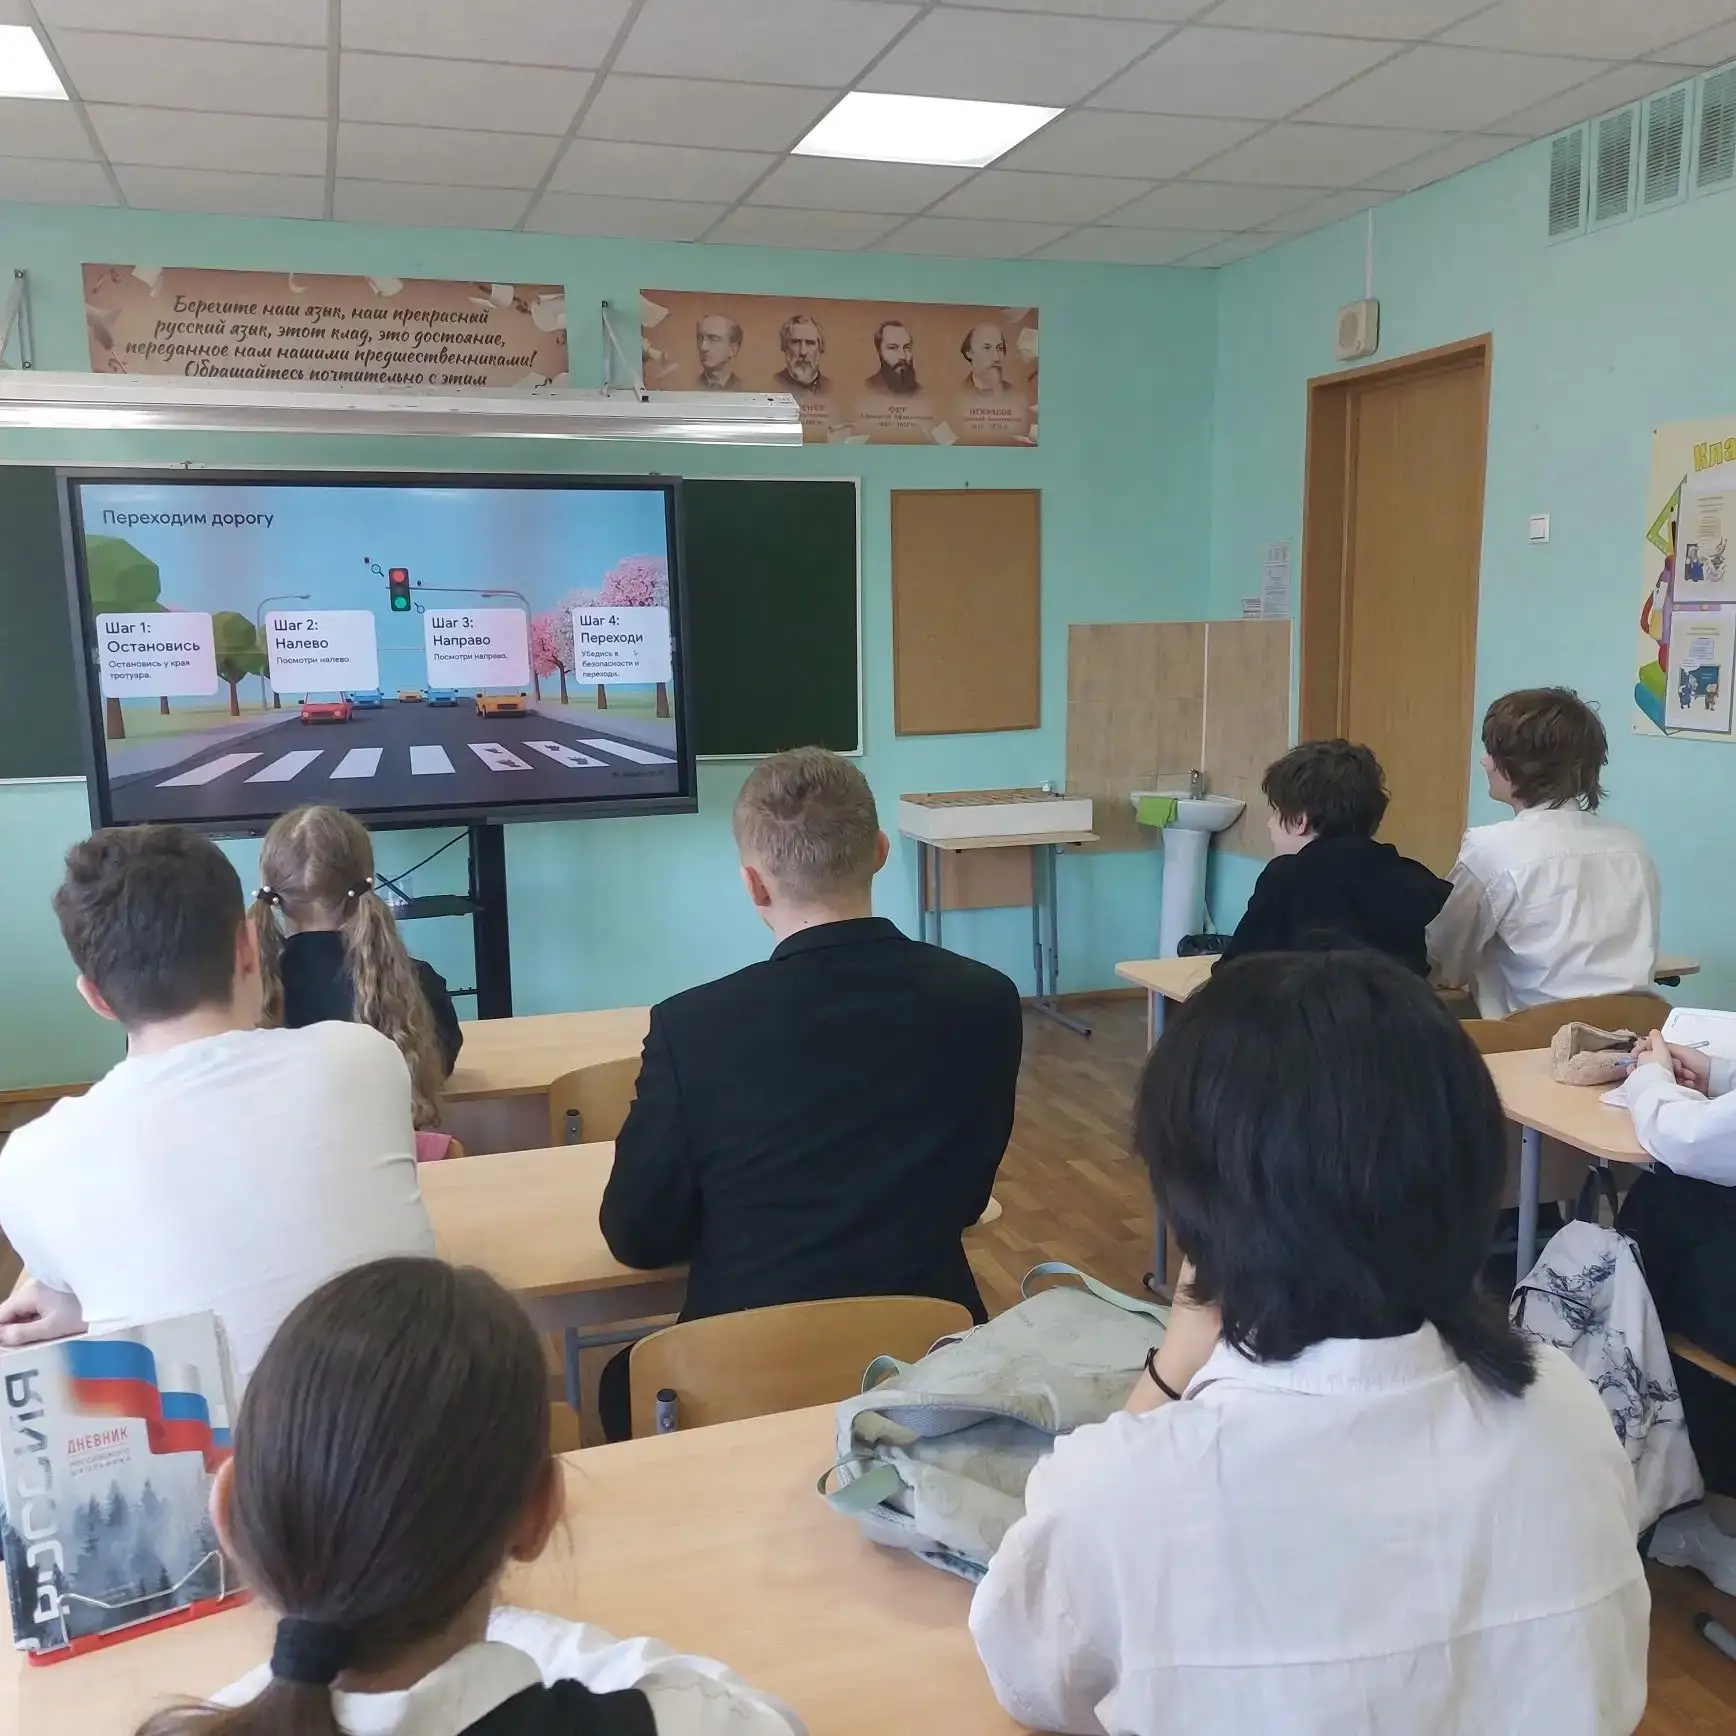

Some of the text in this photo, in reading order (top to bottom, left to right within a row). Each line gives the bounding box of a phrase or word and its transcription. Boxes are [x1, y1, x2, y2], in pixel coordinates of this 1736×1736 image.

[174, 295, 490, 328] Берегите наш язык, наш прекрасный
[154, 319, 506, 349] русский язык, этот клад, это достояние,
[125, 341, 539, 370] переданное нам нашими предшественниками!
[309, 366, 425, 386] почтительно
[428, 373, 437, 385] с
[441, 372, 488, 387] этим
[103, 509, 274, 529] Переходим дорогу
[274, 619, 318, 632] Шаг 2:
[432, 616, 474, 629] Шаг 3:
[580, 615, 620, 627] Шаг 4:
[105, 621, 151, 635] Шаг 1:
[275, 637, 329, 650] Налево
[433, 635, 491, 648] Направо
[581, 632, 644, 645] Переходи
[107, 640, 200, 653] Остановись
[108, 660, 162, 669] Остановись
[170, 659, 191, 668] края
[276, 656, 318, 665] Посмотри
[434, 653, 472, 662] Посмотри
[68, 1426, 128, 1454] ДНЕВНИК
